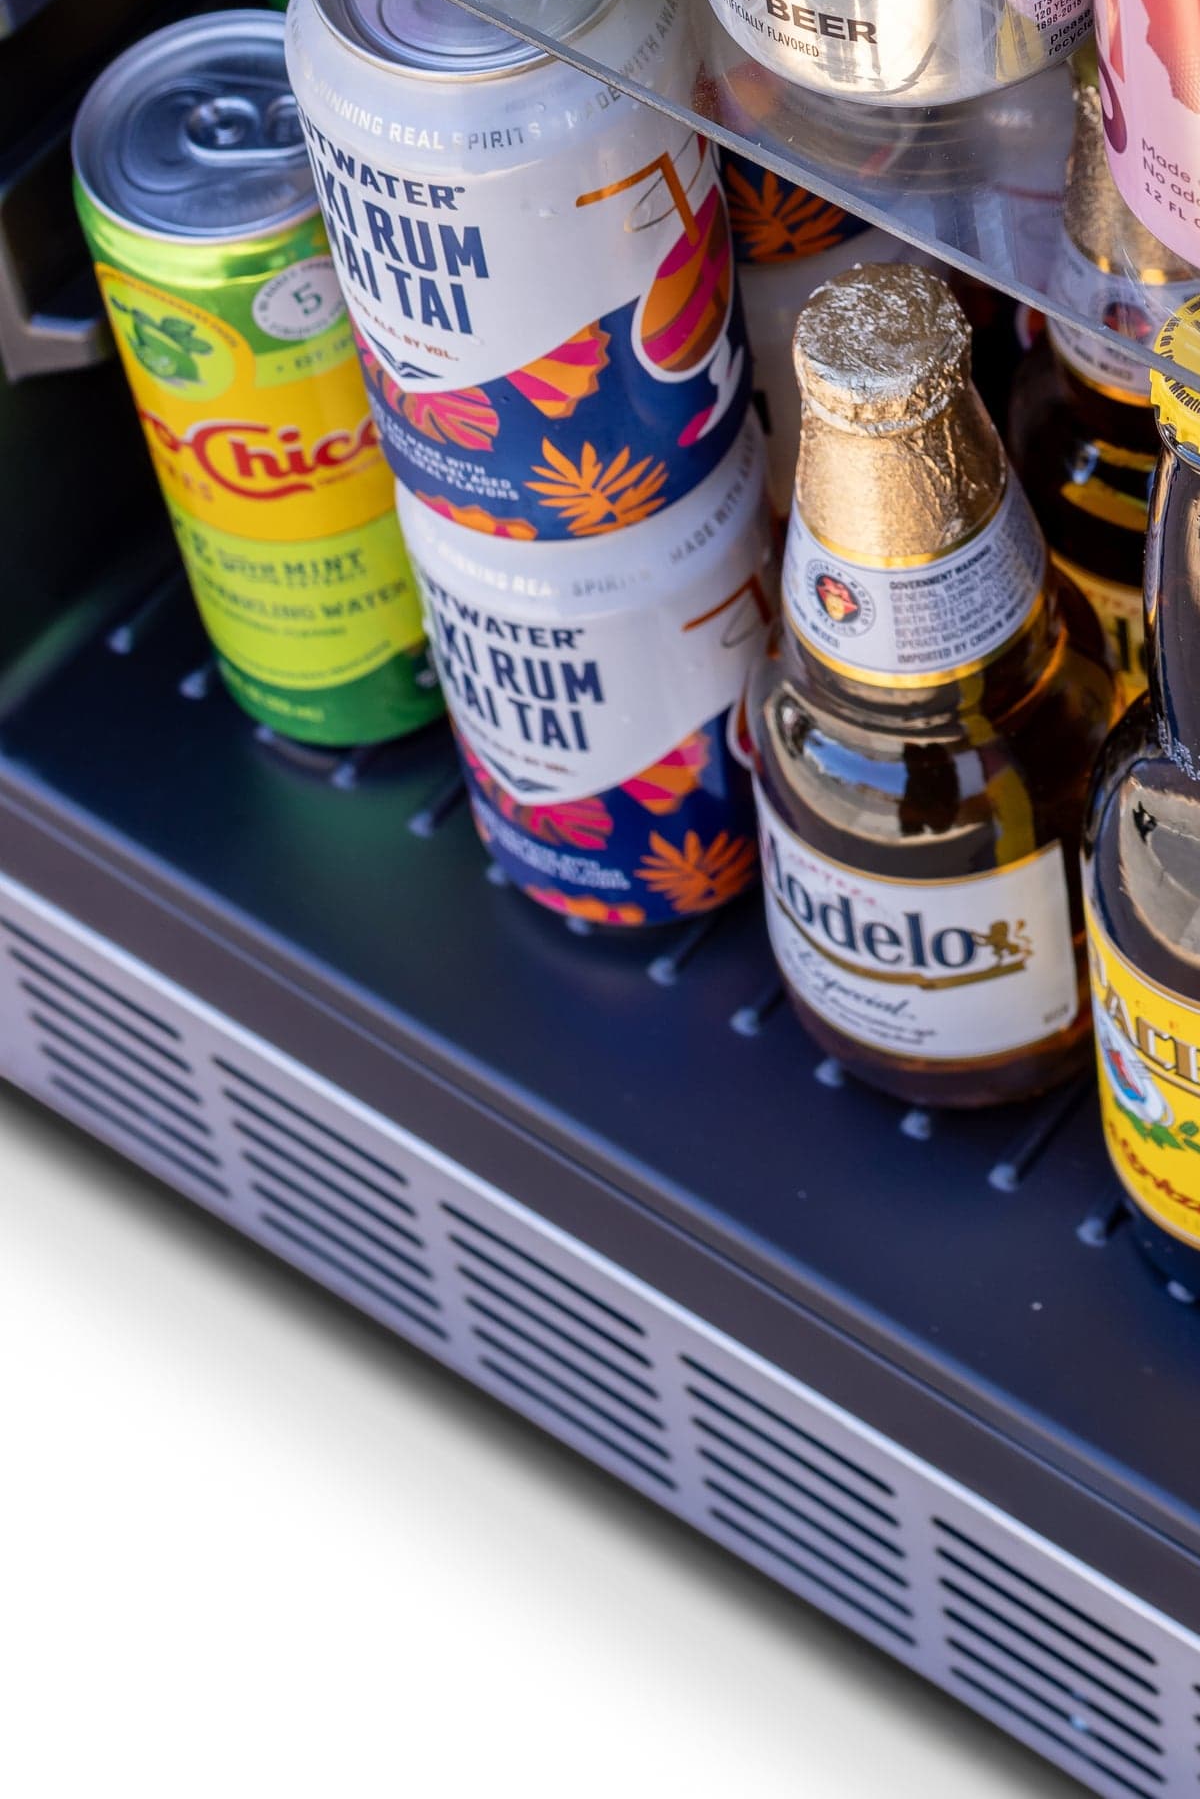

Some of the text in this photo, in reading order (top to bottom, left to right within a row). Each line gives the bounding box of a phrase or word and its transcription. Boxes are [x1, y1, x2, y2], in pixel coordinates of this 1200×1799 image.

[1034, 5, 1053, 22] 120
[1050, 9, 1092, 45] please
[767, 25, 820, 58] FLAVORED
[389, 121, 446, 151] REAL
[1141, 137, 1192, 184] Made
[1143, 158, 1166, 186] No
[1167, 201, 1188, 222] FL
[362, 198, 491, 280] RUM
[292, 282, 323, 316] 5
[385, 261, 474, 336] TAI
[488, 646, 607, 705] RUM
[507, 696, 592, 753] TAI
